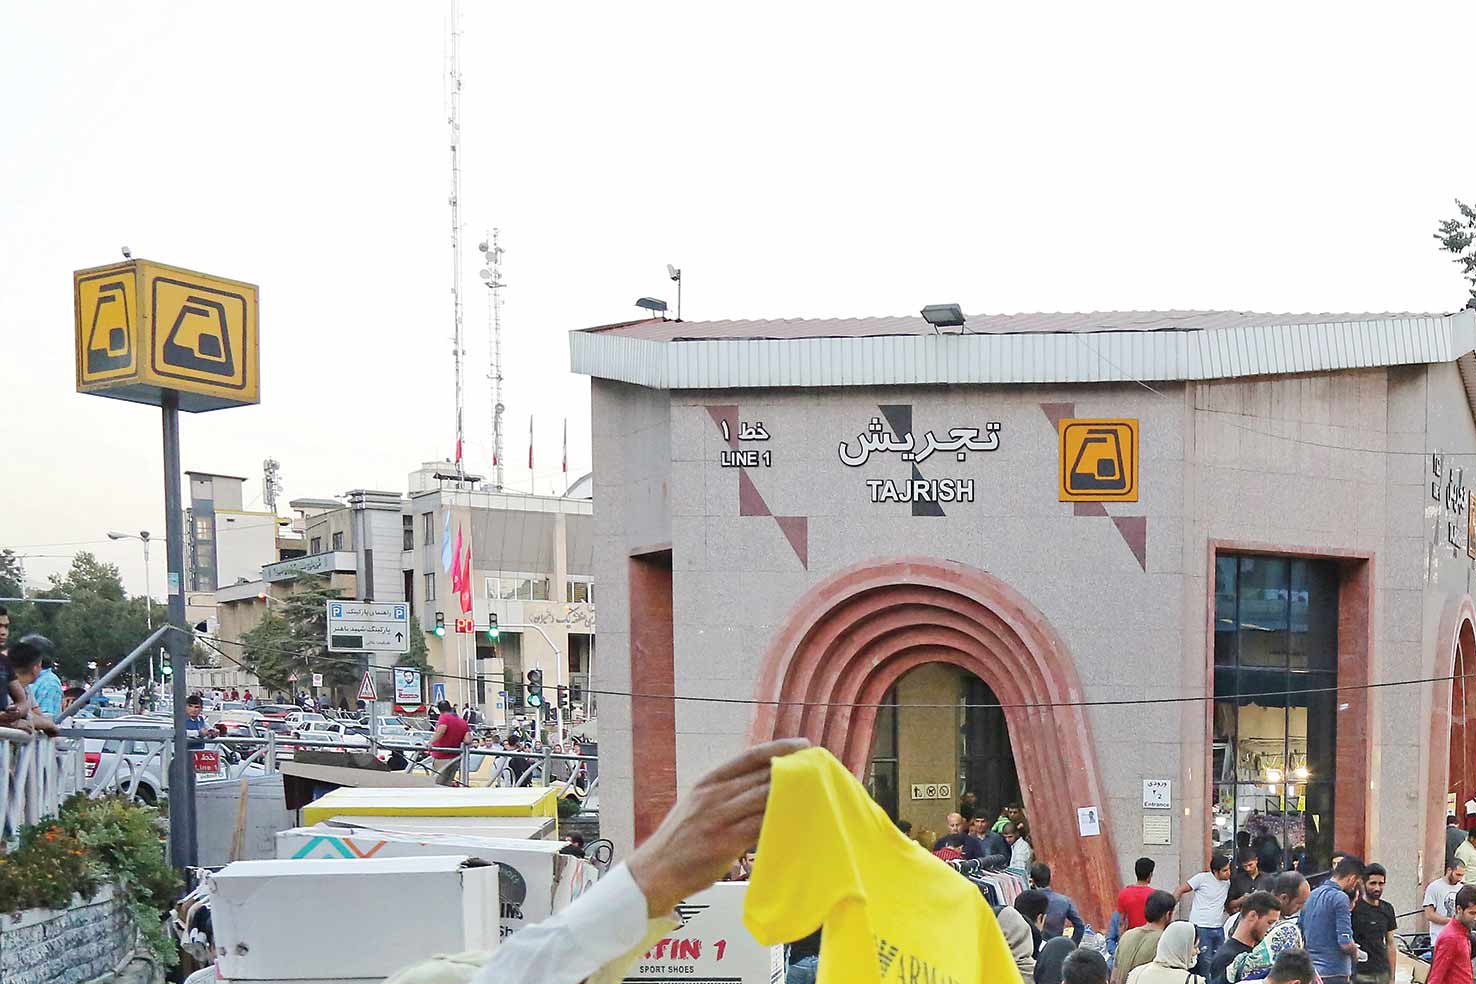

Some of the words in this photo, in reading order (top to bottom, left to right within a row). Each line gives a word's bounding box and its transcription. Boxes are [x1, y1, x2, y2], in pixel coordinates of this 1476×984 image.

[738, 421, 771, 441] خط
[838, 417, 1001, 466] تجریش
[721, 451, 759, 467] LINE
[762, 451, 771, 467] 1
[866, 479, 975, 502] TAJRISH
[713, 939, 727, 961] 1
[640, 965, 665, 974] SPORT
[668, 965, 694, 974] SHOES
